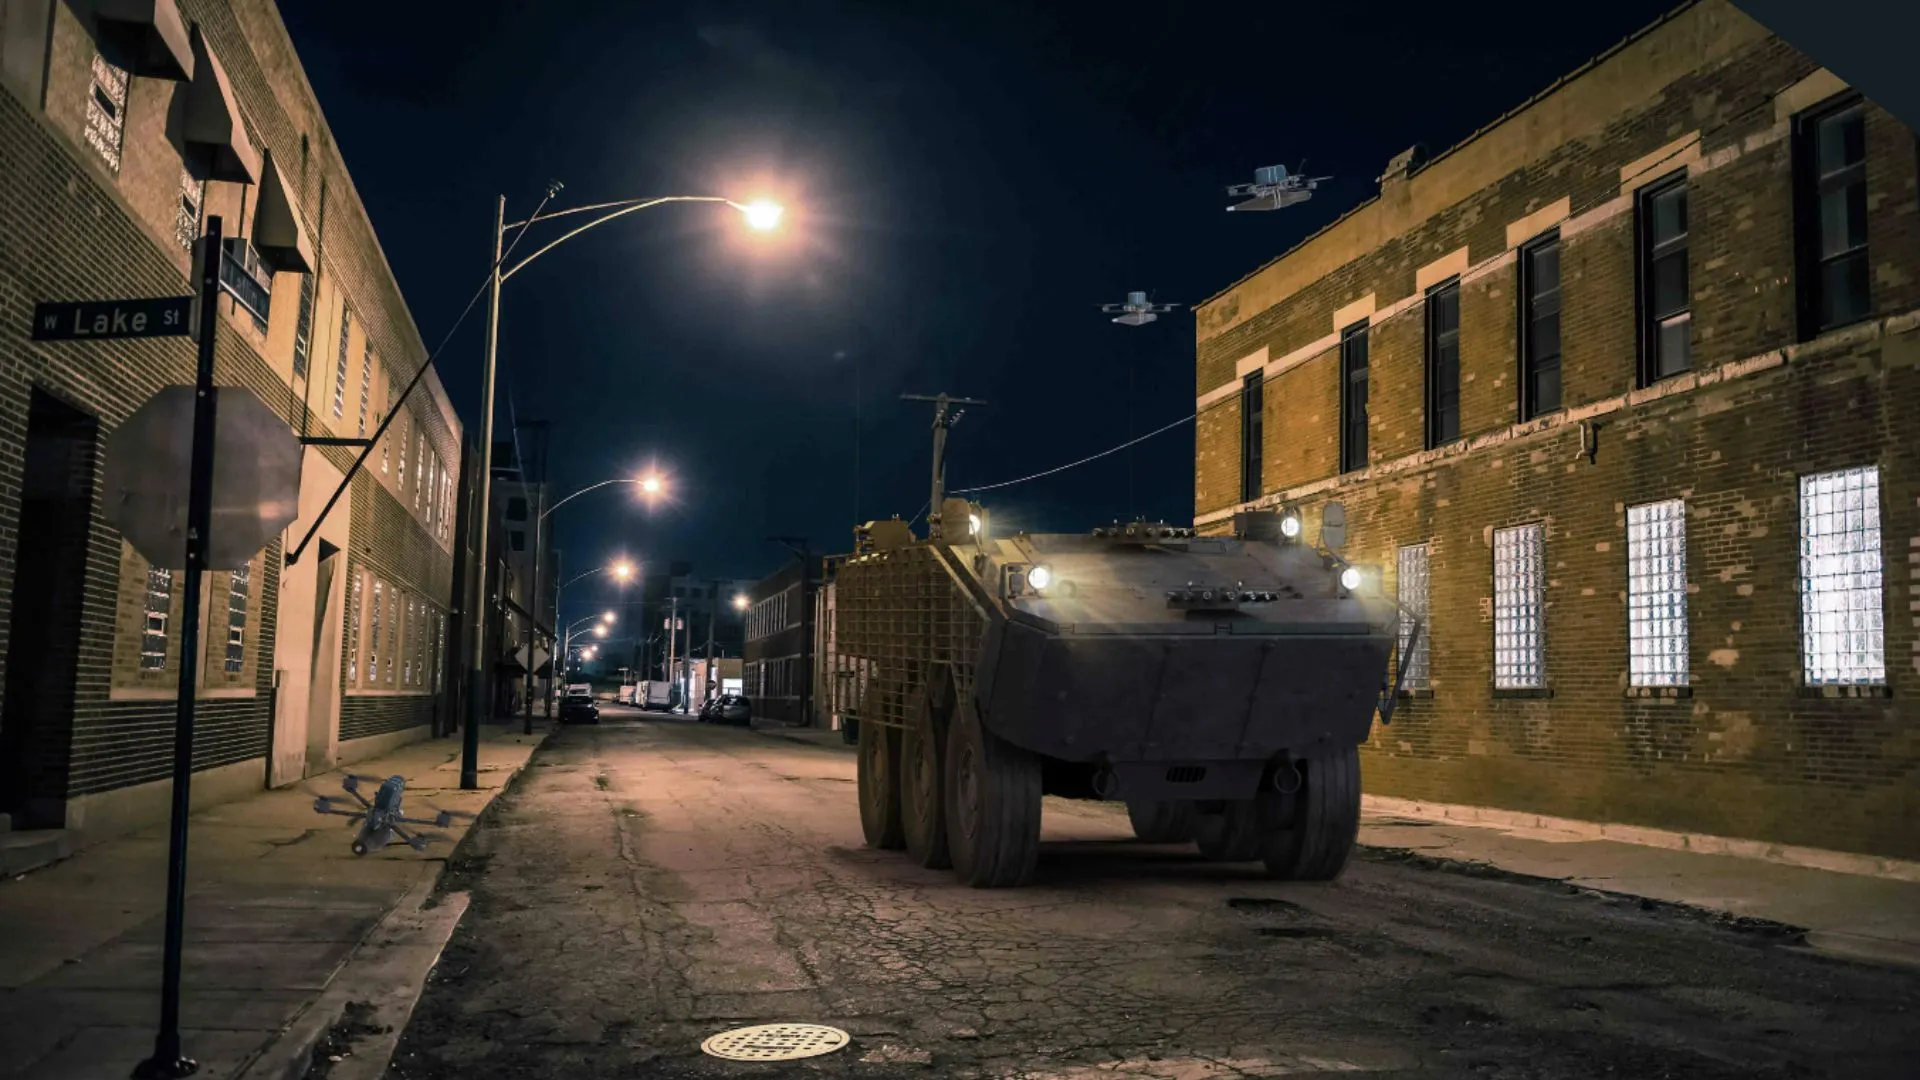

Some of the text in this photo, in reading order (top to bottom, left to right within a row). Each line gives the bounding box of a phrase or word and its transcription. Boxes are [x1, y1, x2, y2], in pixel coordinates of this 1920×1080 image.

[44, 308, 180, 334] W Lake St
